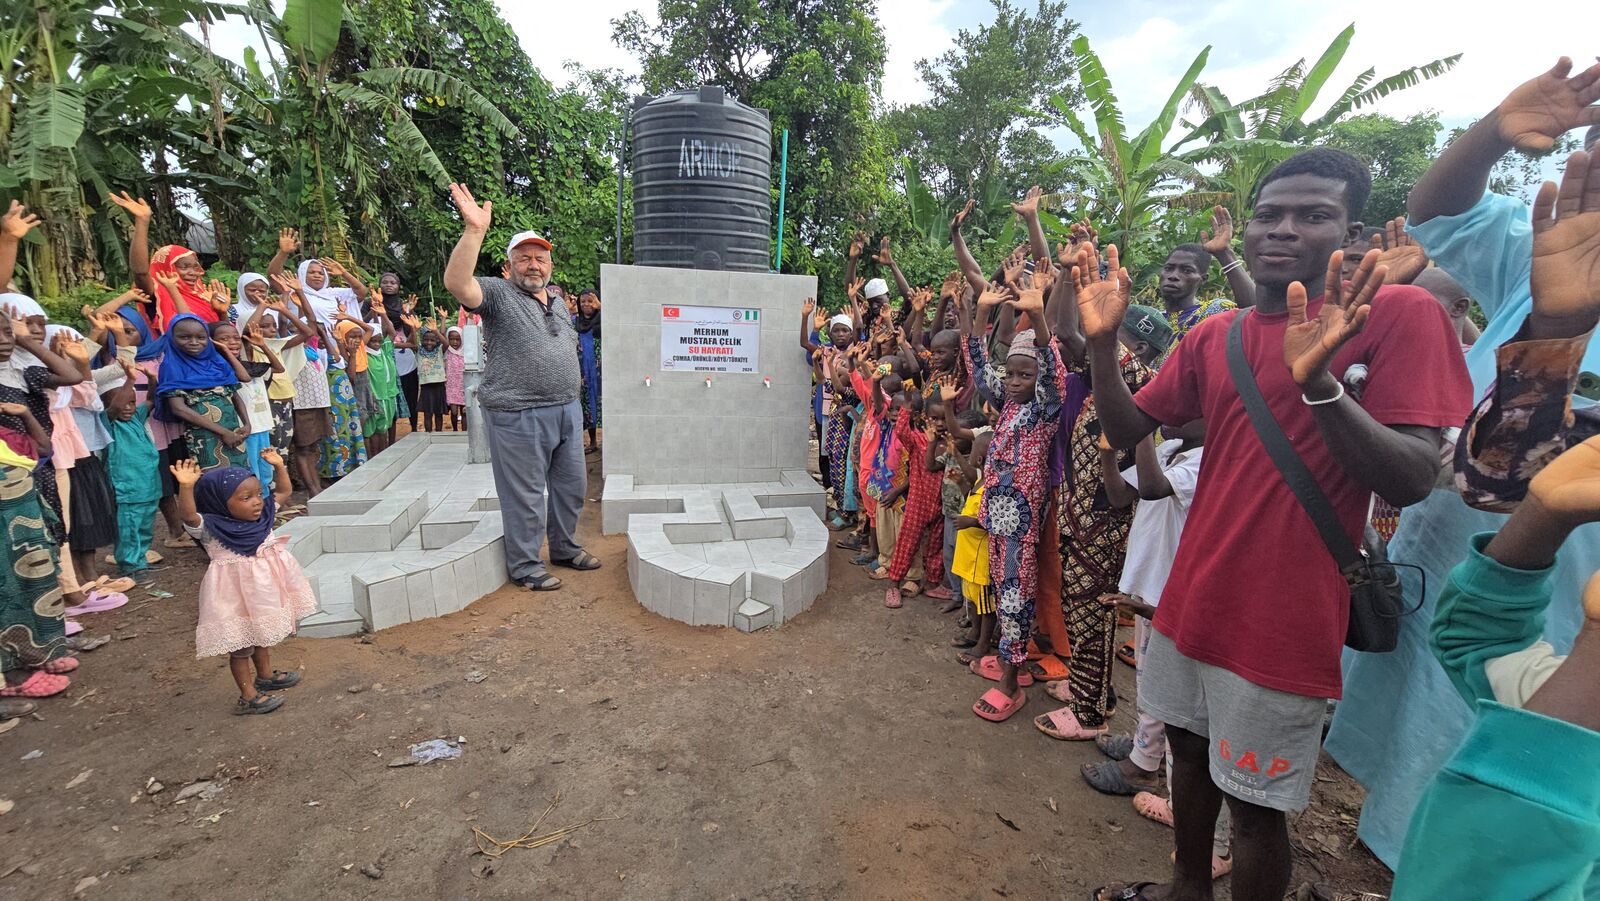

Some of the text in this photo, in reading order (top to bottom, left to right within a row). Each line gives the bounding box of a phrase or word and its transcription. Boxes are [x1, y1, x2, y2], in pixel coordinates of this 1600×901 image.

[694, 328, 729, 336] MERHUM
[680, 337, 742, 347] MUSTAFA ÇELİK
[701, 347, 734, 355] HAYRATI
[1219, 738, 1290, 778] GAP
[1231, 769, 1257, 785] EST.
